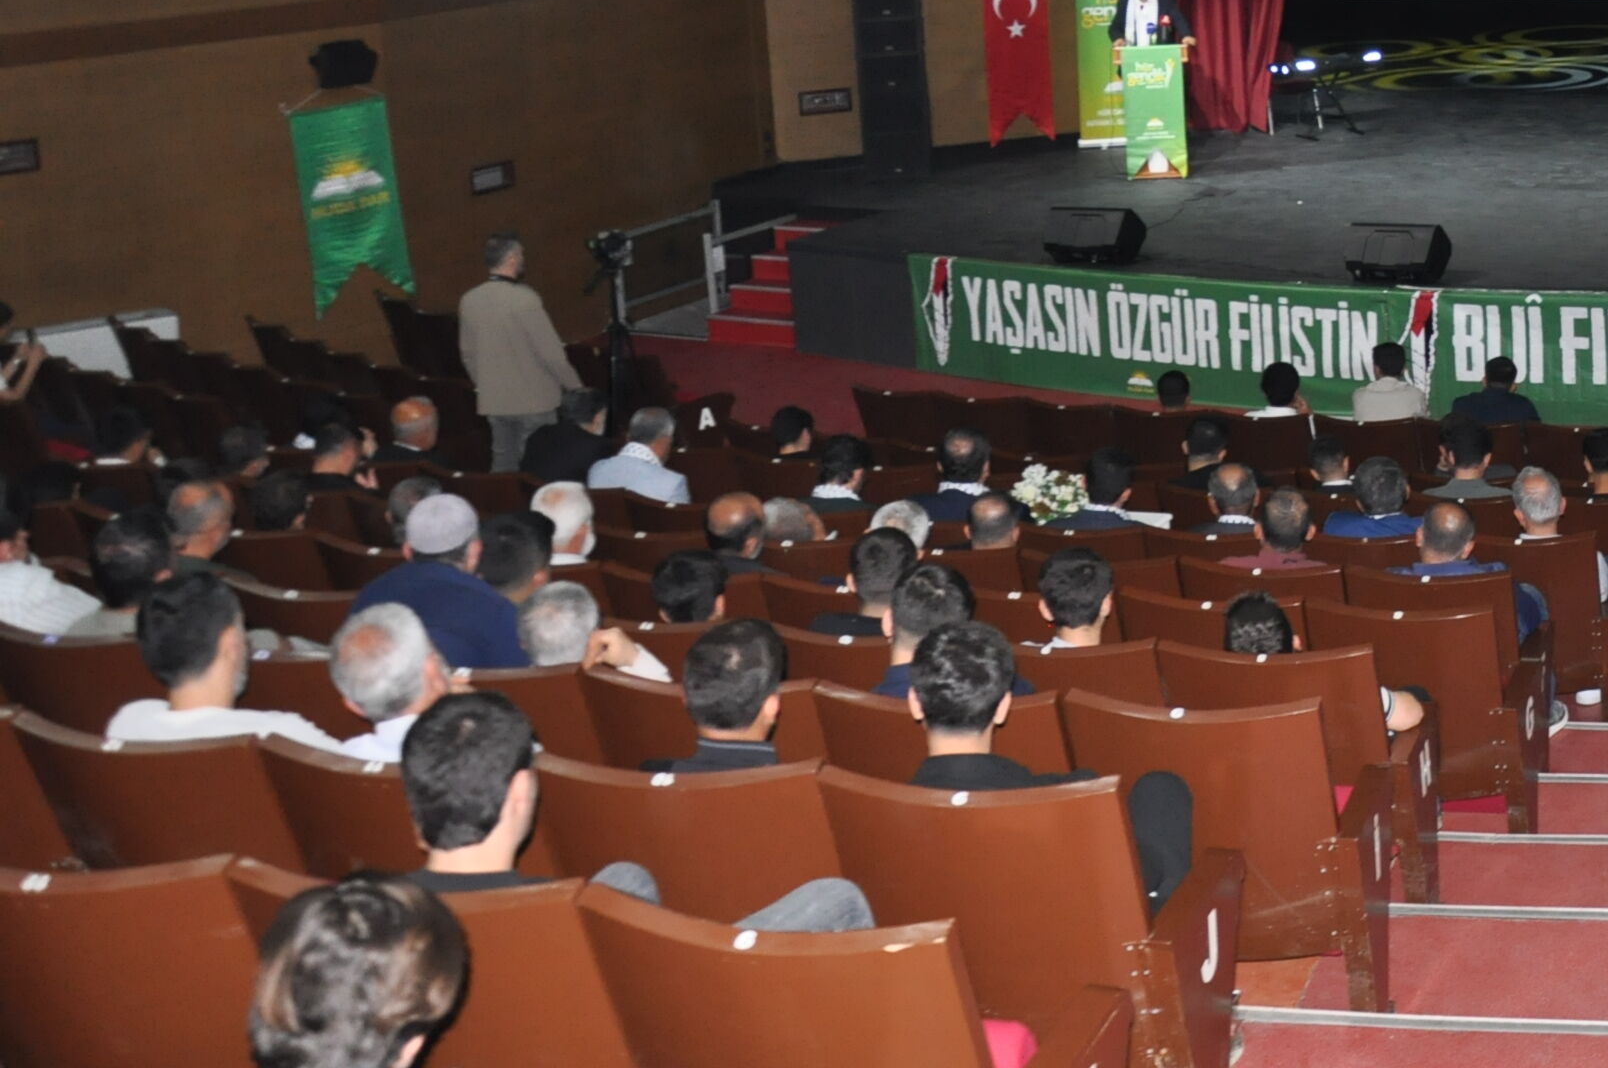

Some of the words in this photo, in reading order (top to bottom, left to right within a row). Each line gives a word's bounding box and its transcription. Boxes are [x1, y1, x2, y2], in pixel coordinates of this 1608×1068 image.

[960, 275, 1101, 355] YAŞASIN
[1106, 282, 1221, 369] ÖZGÜR
[1228, 294, 1379, 382] FİLİSTİN
[699, 406, 717, 431] A
[1525, 695, 1536, 741] G
[1419, 738, 1432, 798] H
[1200, 907, 1219, 984] J
